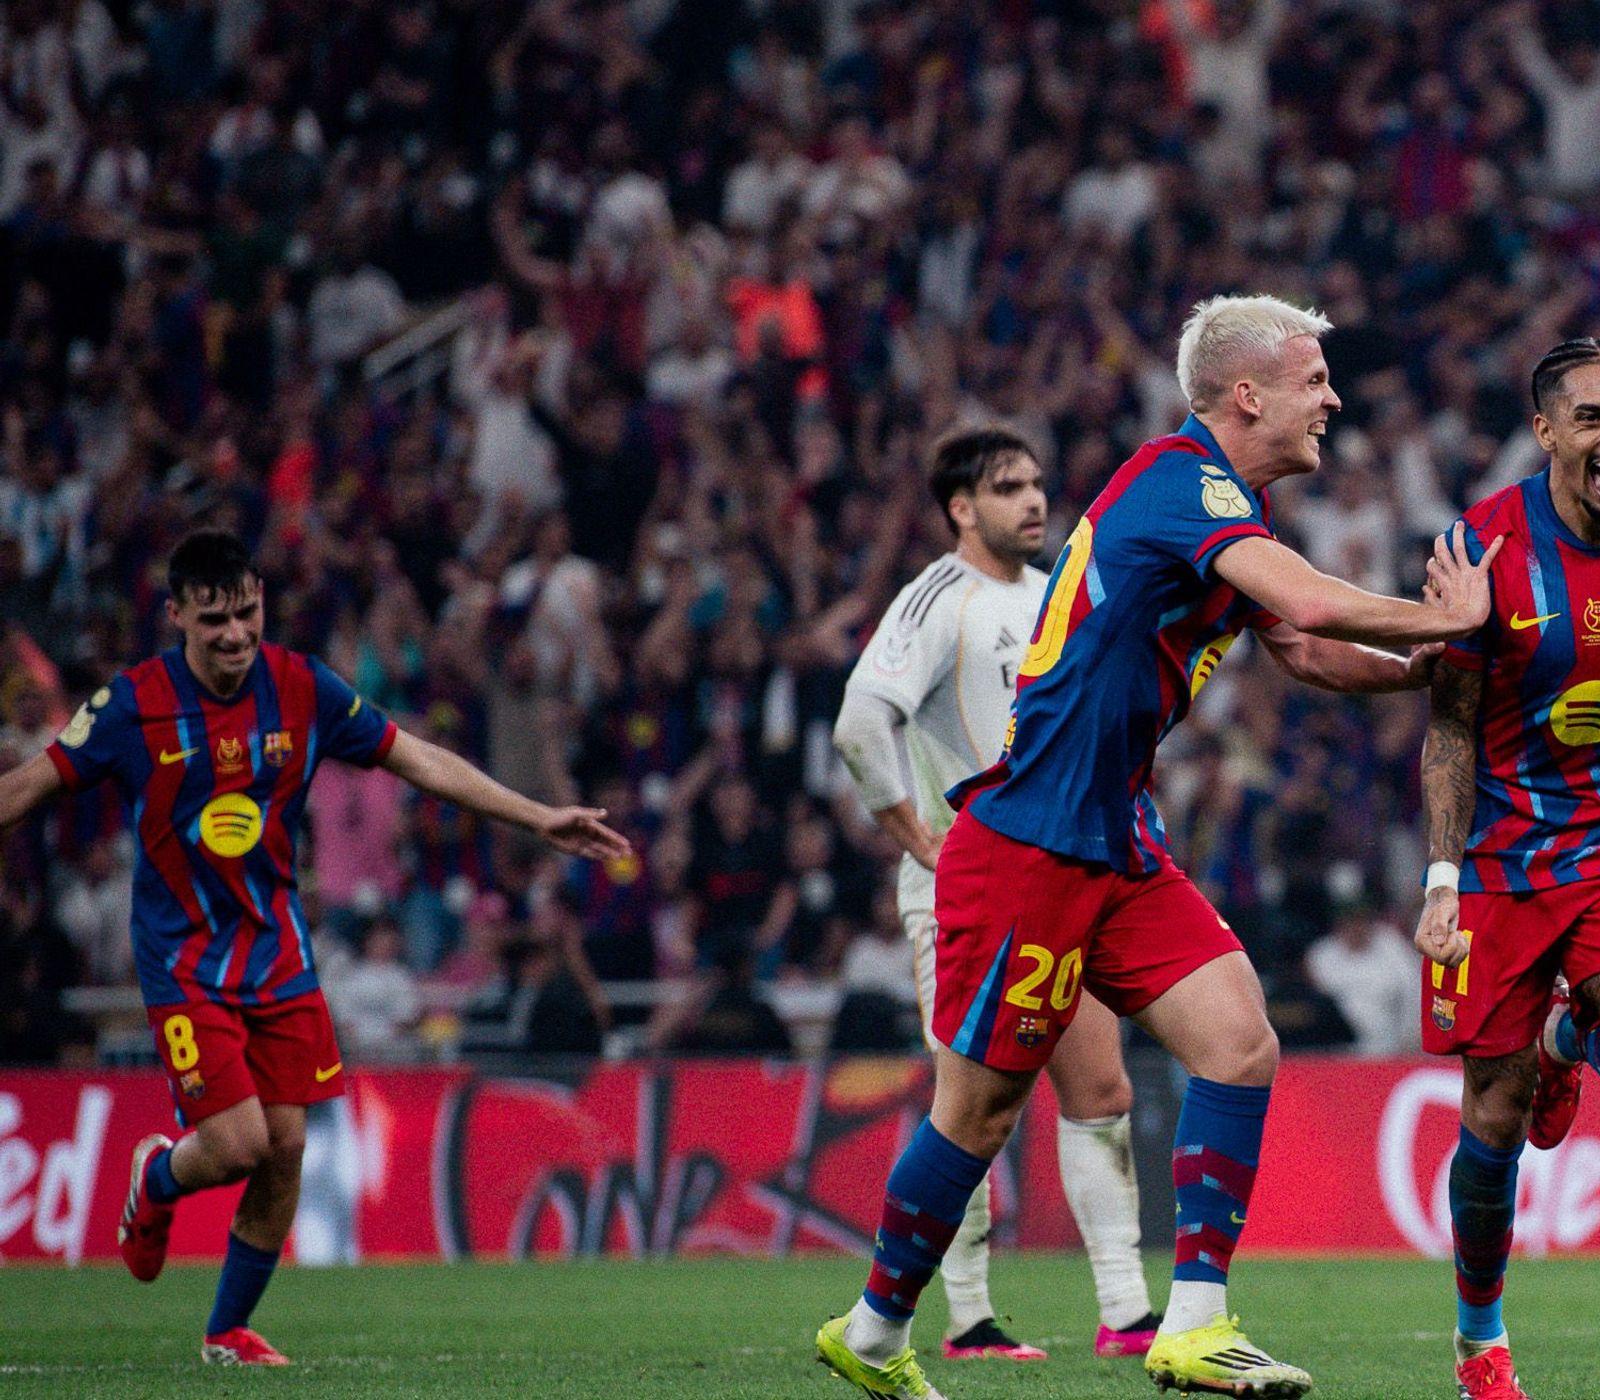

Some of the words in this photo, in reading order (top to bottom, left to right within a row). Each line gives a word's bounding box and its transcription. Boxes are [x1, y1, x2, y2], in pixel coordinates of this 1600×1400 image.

[1004, 944, 1083, 1011] 20
[163, 1014, 200, 1072] 8
[0, 1084, 114, 1267] ed
